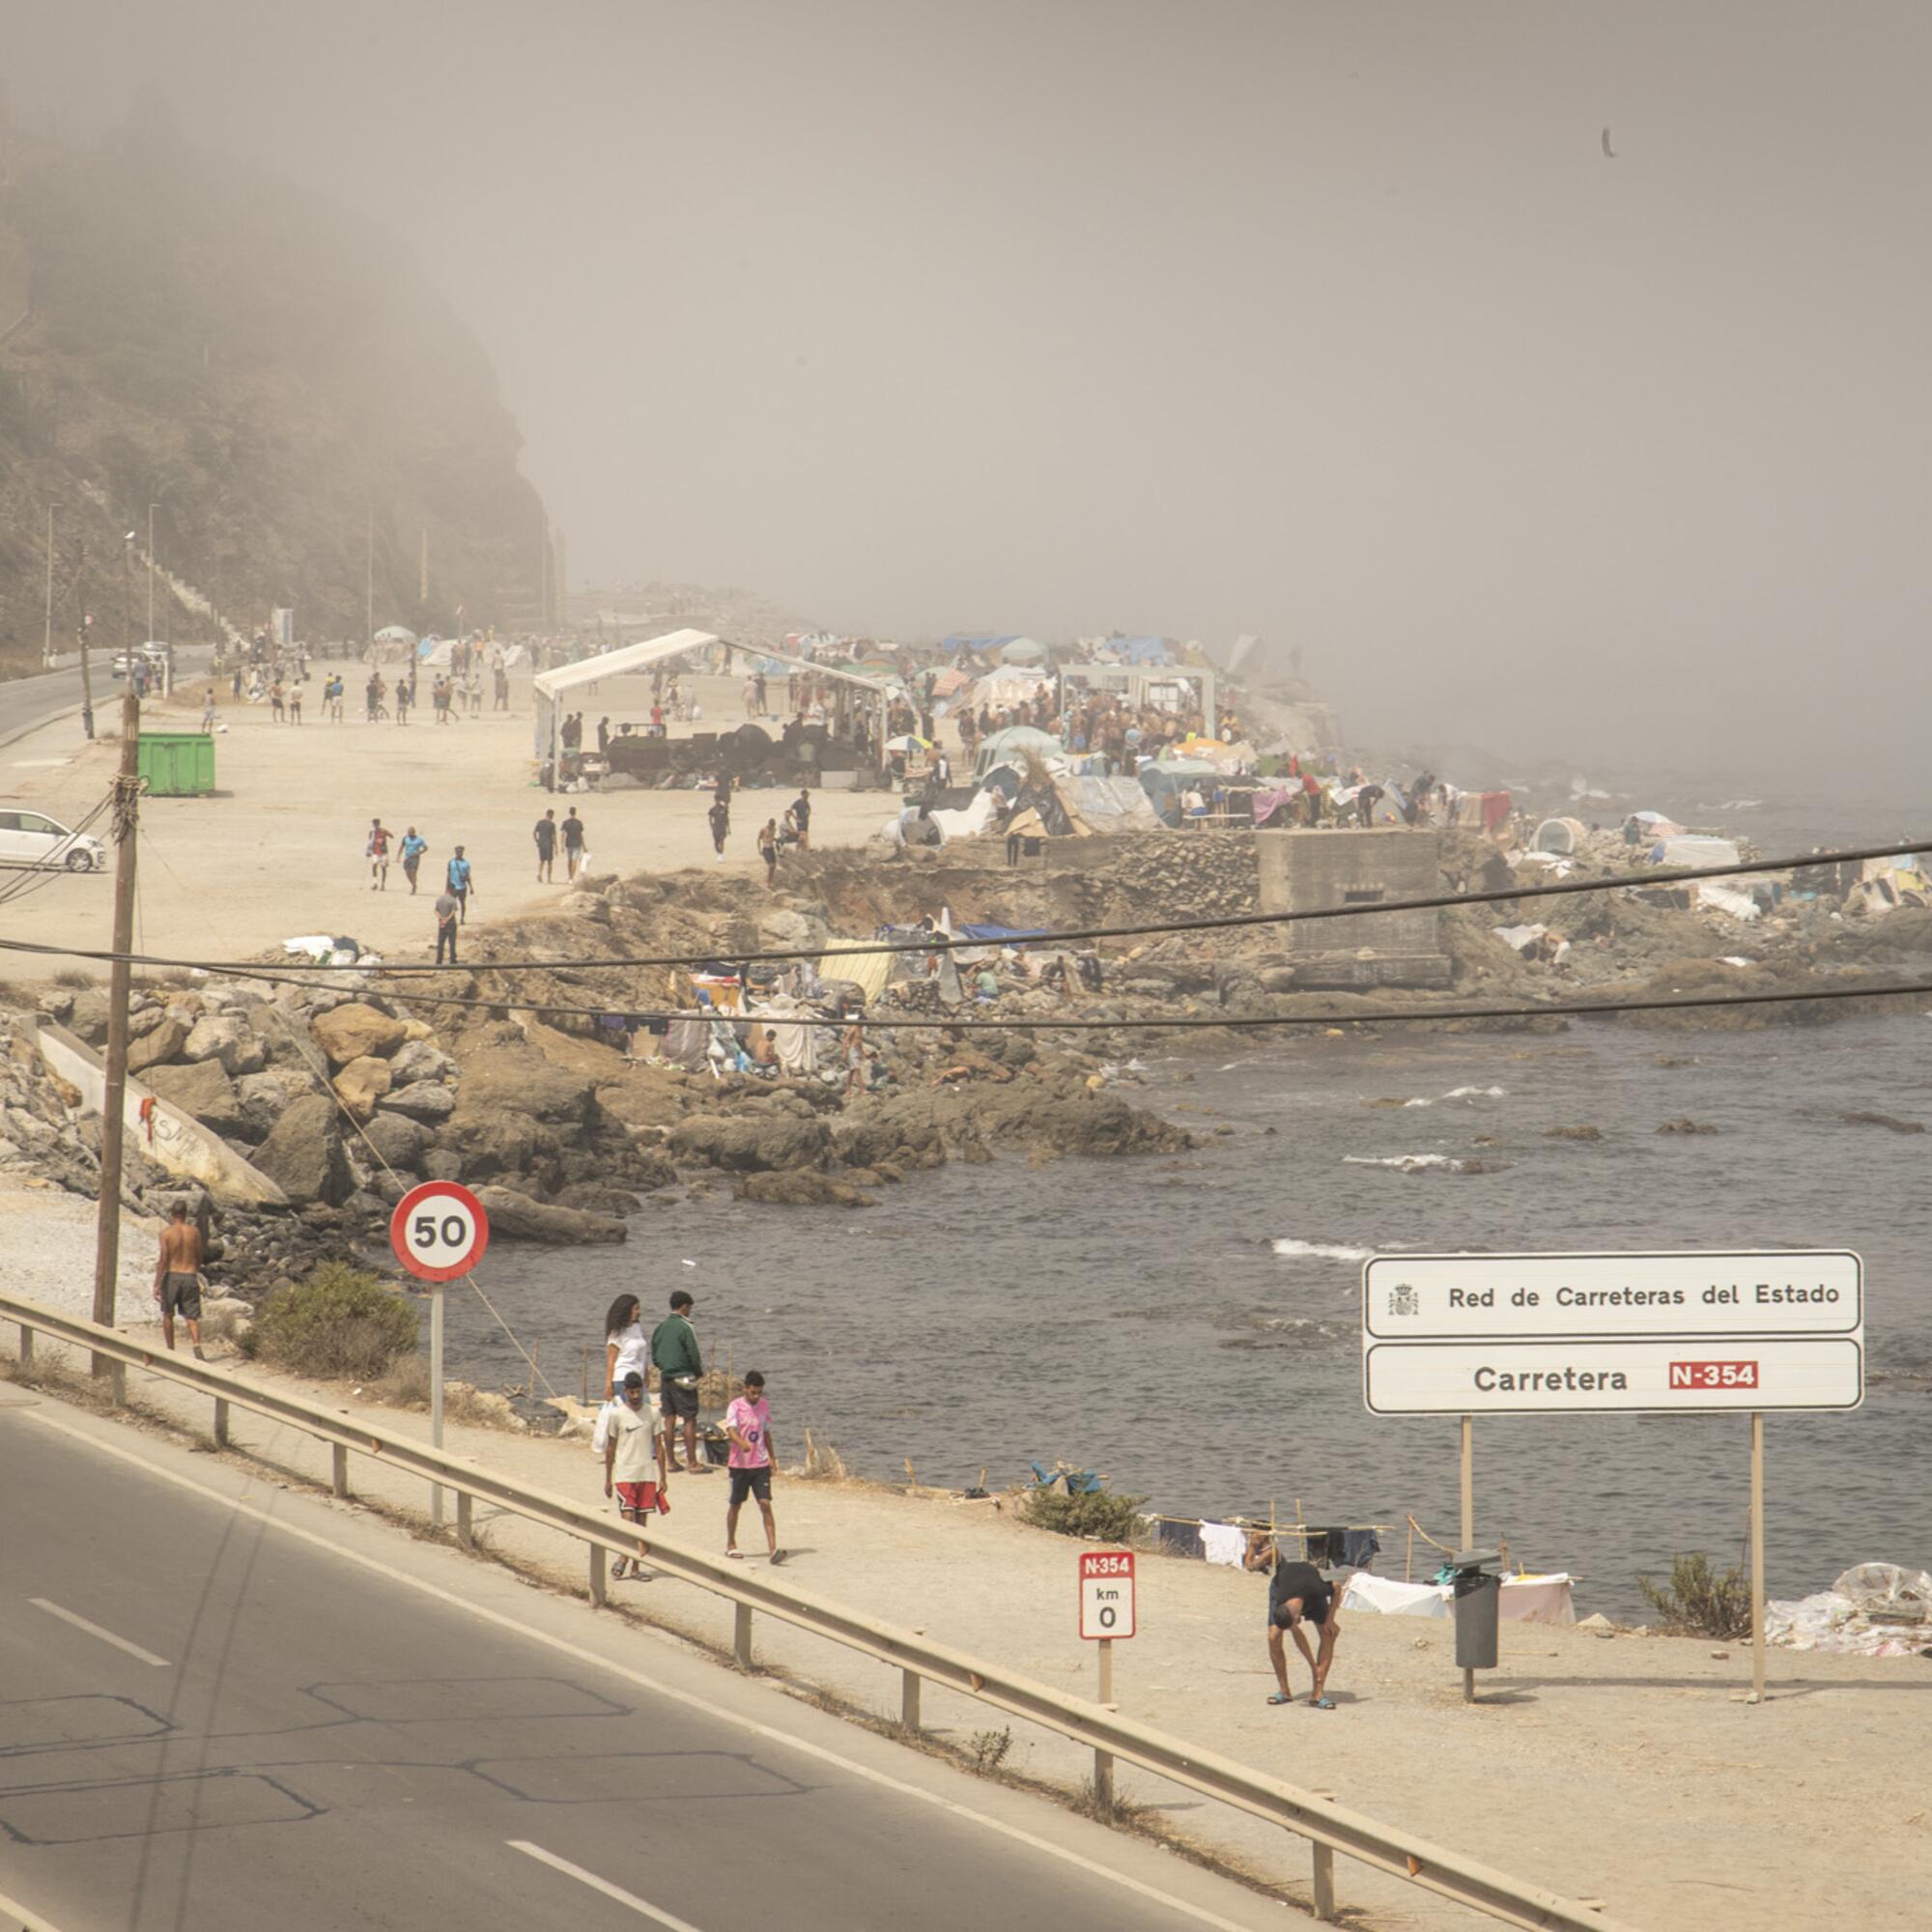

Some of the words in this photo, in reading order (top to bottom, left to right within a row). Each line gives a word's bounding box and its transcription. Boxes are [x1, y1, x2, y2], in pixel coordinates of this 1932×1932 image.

[414, 1215, 467, 1248] 50
[1449, 1288, 1494, 1307] Red
[1511, 1288, 1540, 1307] de
[1556, 1286, 1685, 1306] Carreteras
[1702, 1285, 1739, 1304] del
[1755, 1284, 1839, 1303] Estado
[1474, 1366, 1628, 1391] Carretera
[1672, 1365, 1754, 1385] N-354
[1085, 1557, 1129, 1575] N-354
[1096, 1588, 1119, 1600] km
[1099, 1606, 1116, 1628] 0
